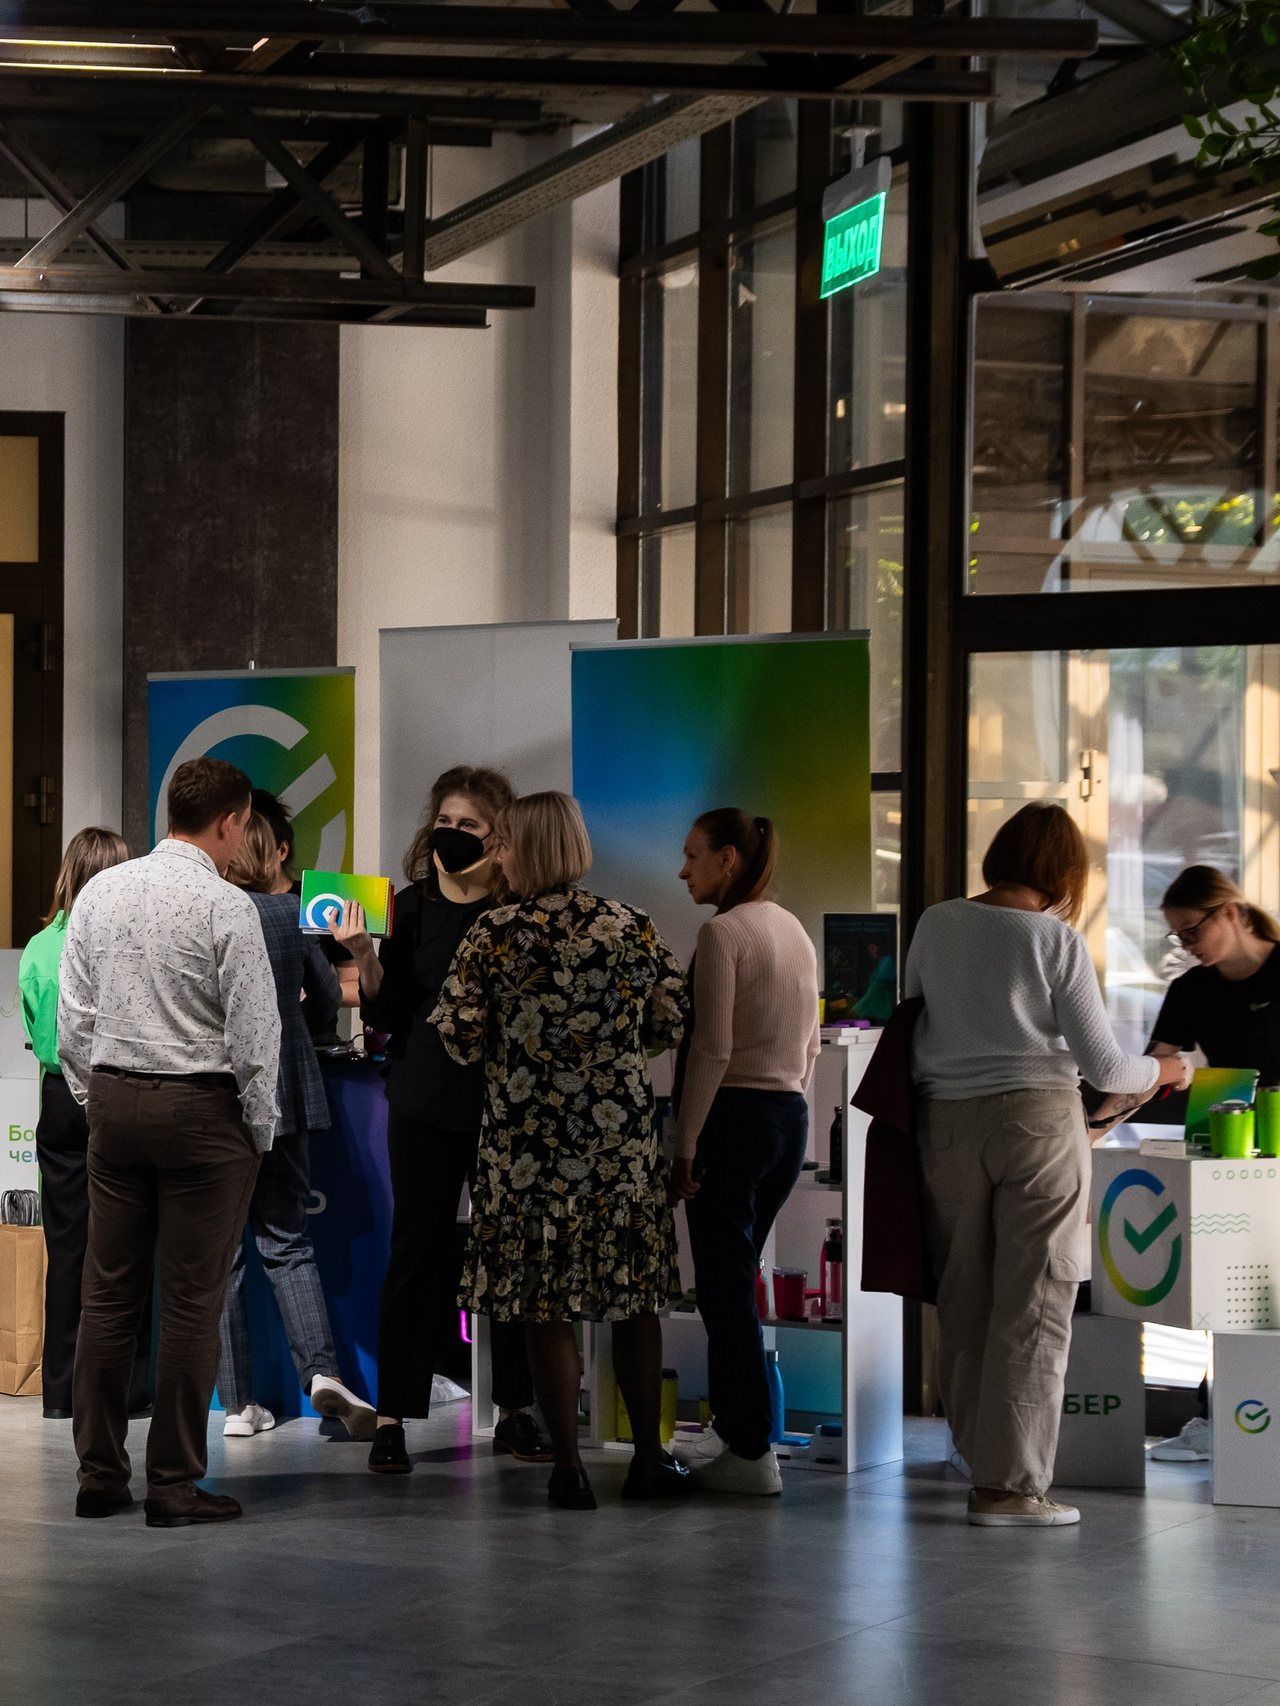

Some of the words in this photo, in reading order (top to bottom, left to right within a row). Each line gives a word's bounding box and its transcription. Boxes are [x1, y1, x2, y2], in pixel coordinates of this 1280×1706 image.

[824, 214, 879, 282] ВЫХОД
[8, 1124, 36, 1142] Бо
[9, 1150, 38, 1163] че
[1063, 1393, 1122, 1415] БЕР
